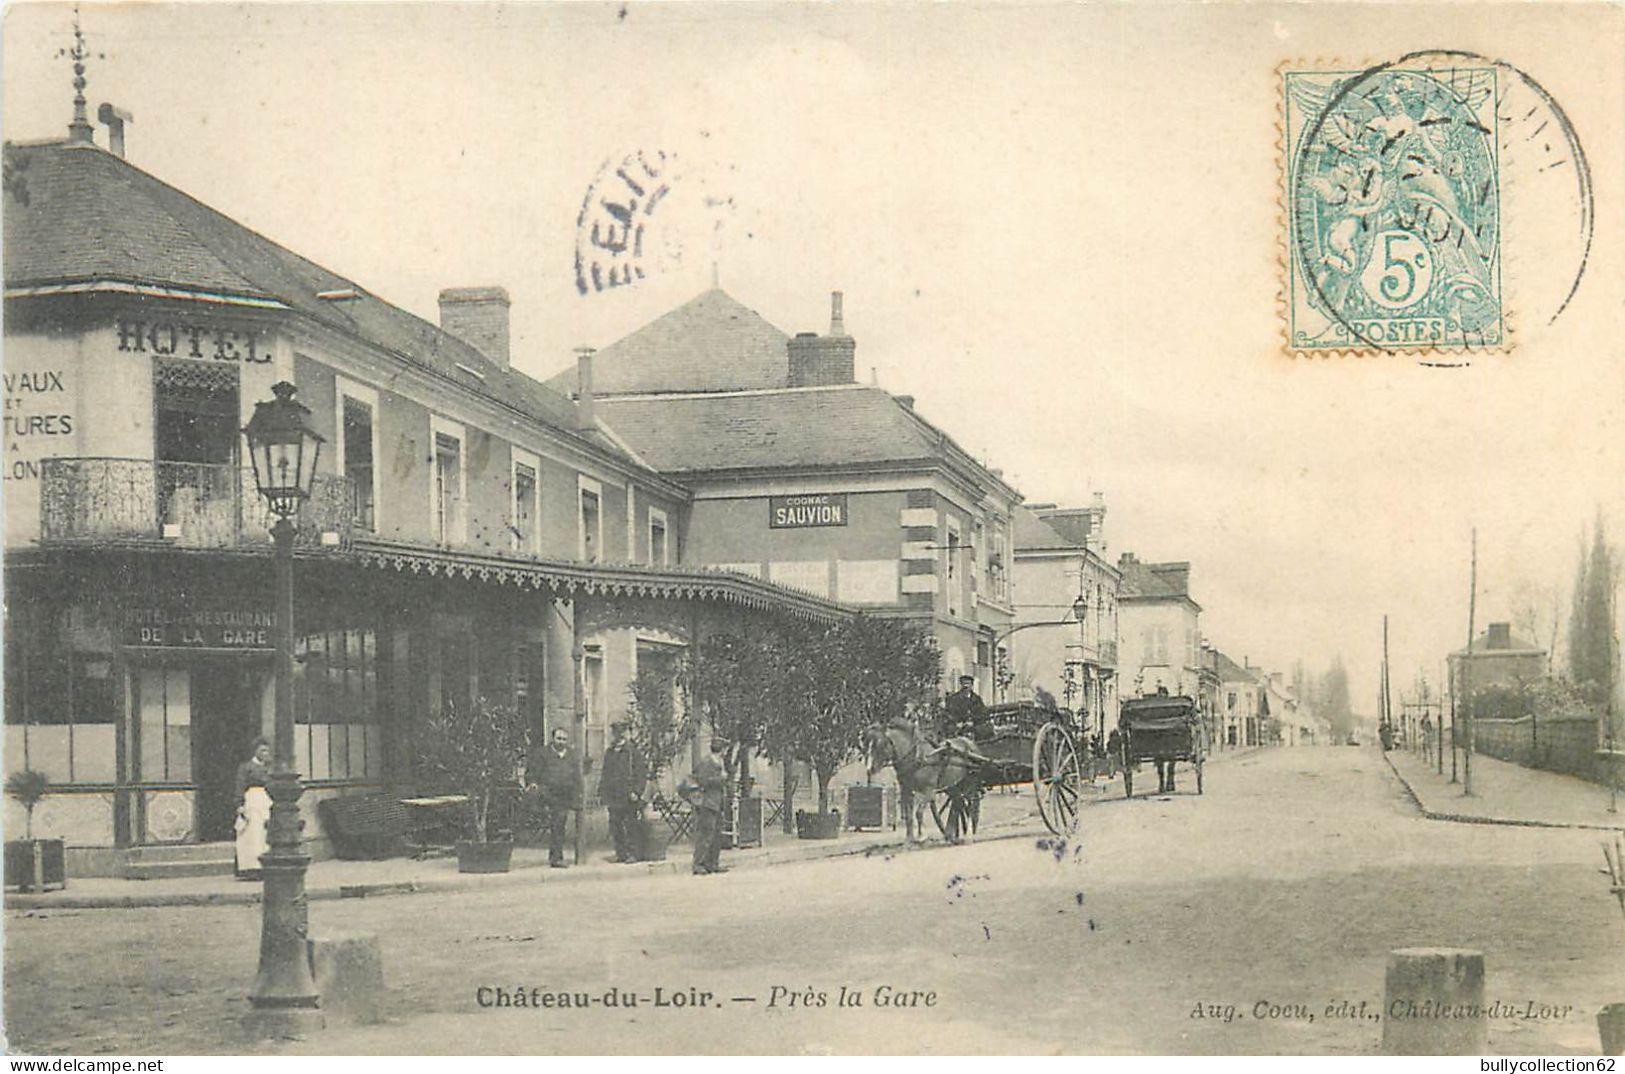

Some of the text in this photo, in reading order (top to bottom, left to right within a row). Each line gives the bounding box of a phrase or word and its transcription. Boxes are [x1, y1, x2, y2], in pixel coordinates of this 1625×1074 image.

[1352, 319, 1442, 343] POSTES
[117, 319, 273, 365] HOTEL
[786, 496, 828, 505] COGNAC
[776, 505, 841, 524] SAUVION
[140, 627, 268, 645] DE LA GARE
